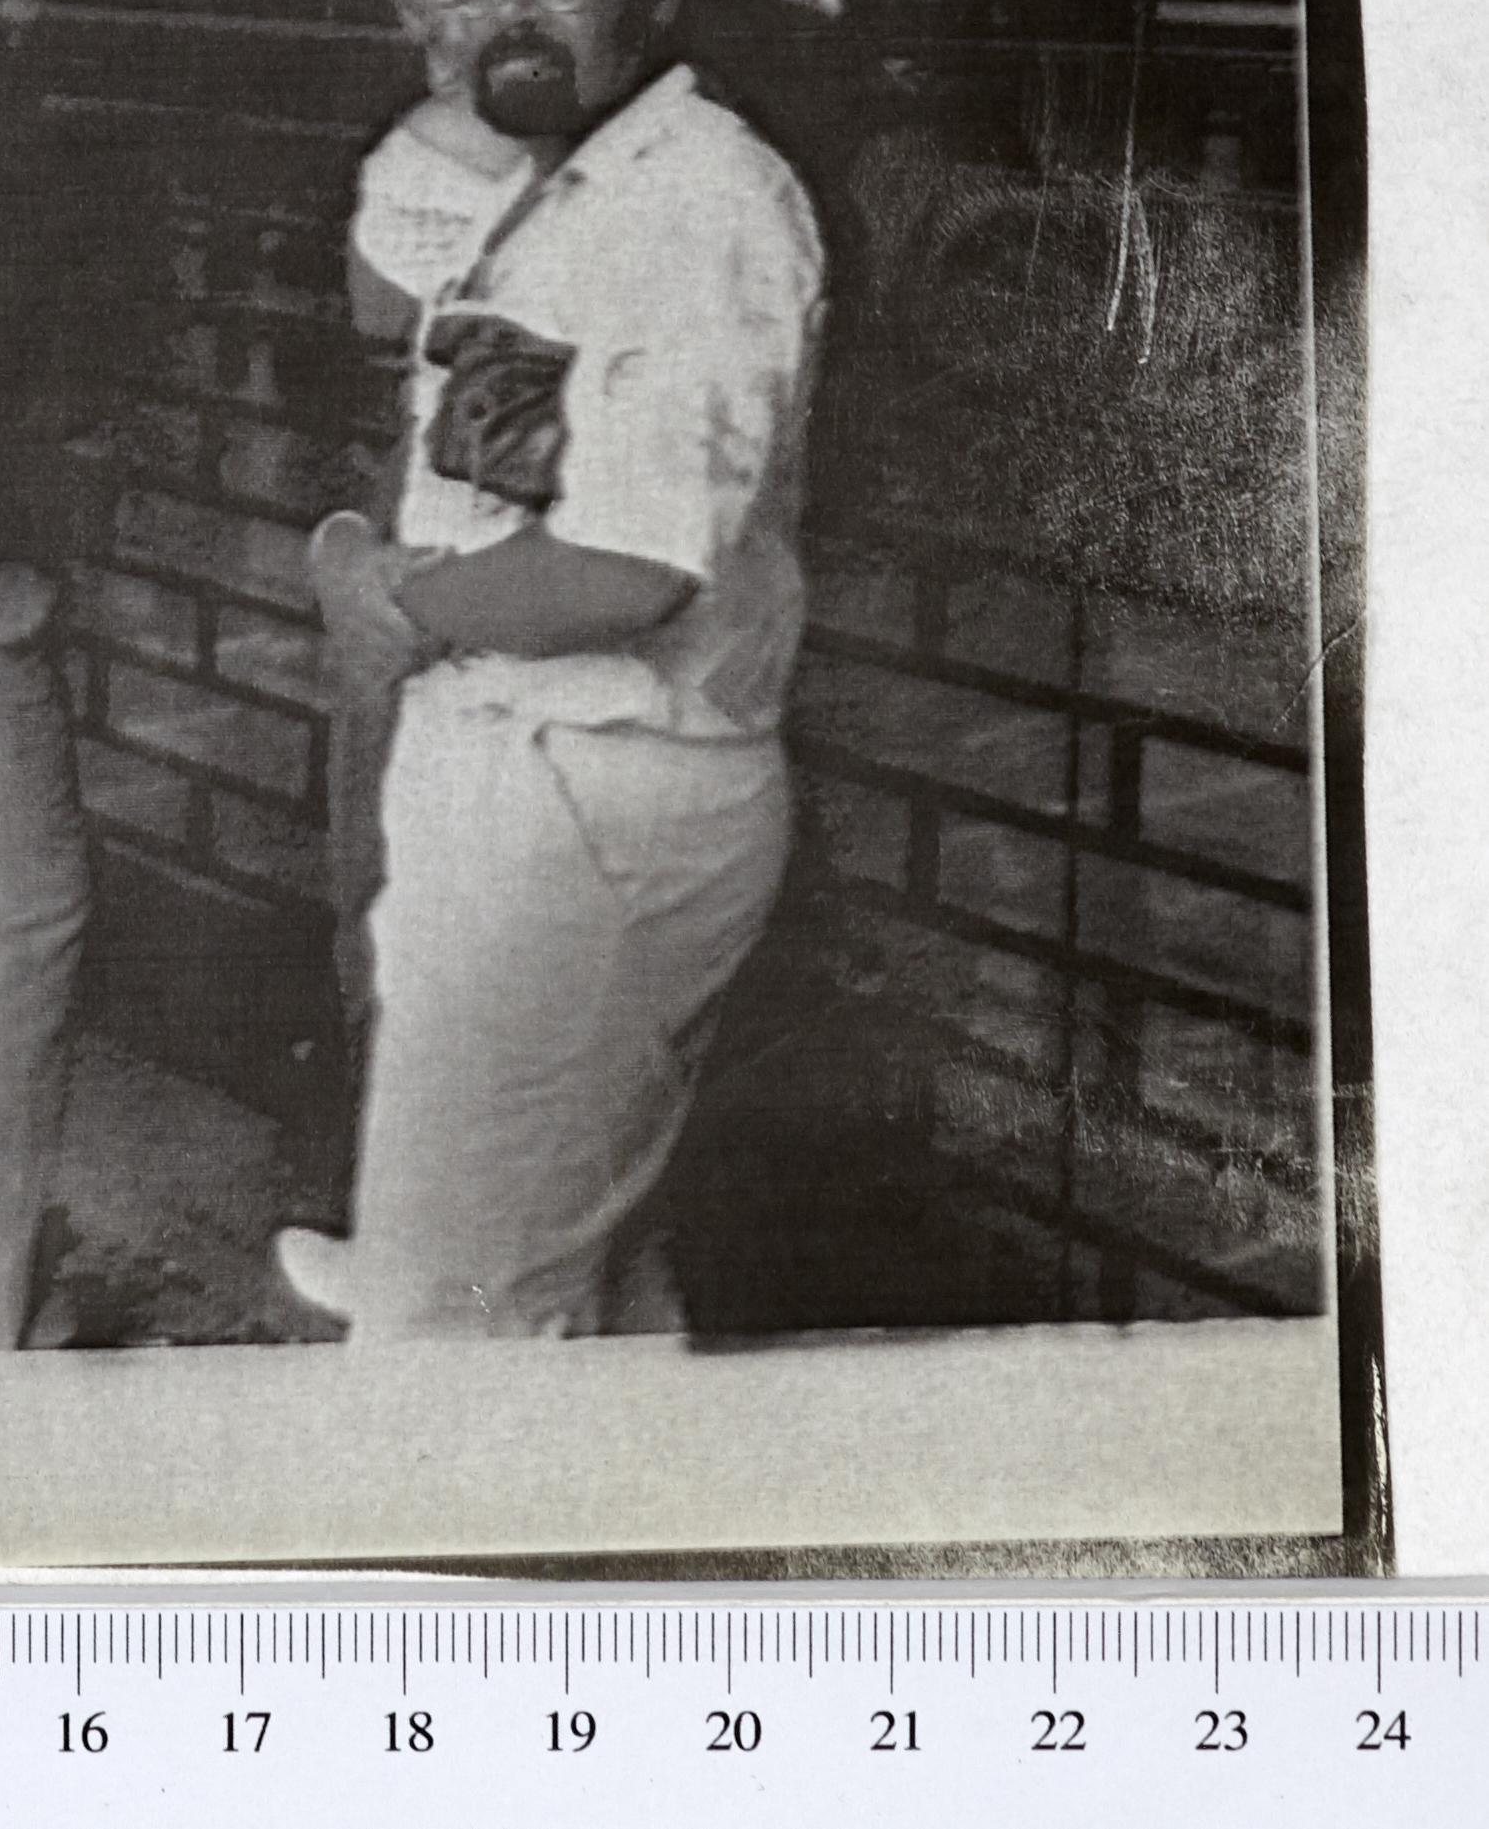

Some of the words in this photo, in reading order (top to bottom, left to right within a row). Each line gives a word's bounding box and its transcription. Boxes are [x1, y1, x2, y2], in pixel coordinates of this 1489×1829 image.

[60, 1712, 109, 1753] 16
[223, 1711, 272, 1753] 17
[386, 1711, 435, 1753] 18
[547, 1711, 597, 1752] 19
[706, 1710, 763, 1752] 20
[870, 1710, 918, 1751] 21
[1031, 1710, 1086, 1751] 22
[1195, 1709, 1249, 1752] 23
[1356, 1709, 1412, 1751] 24
